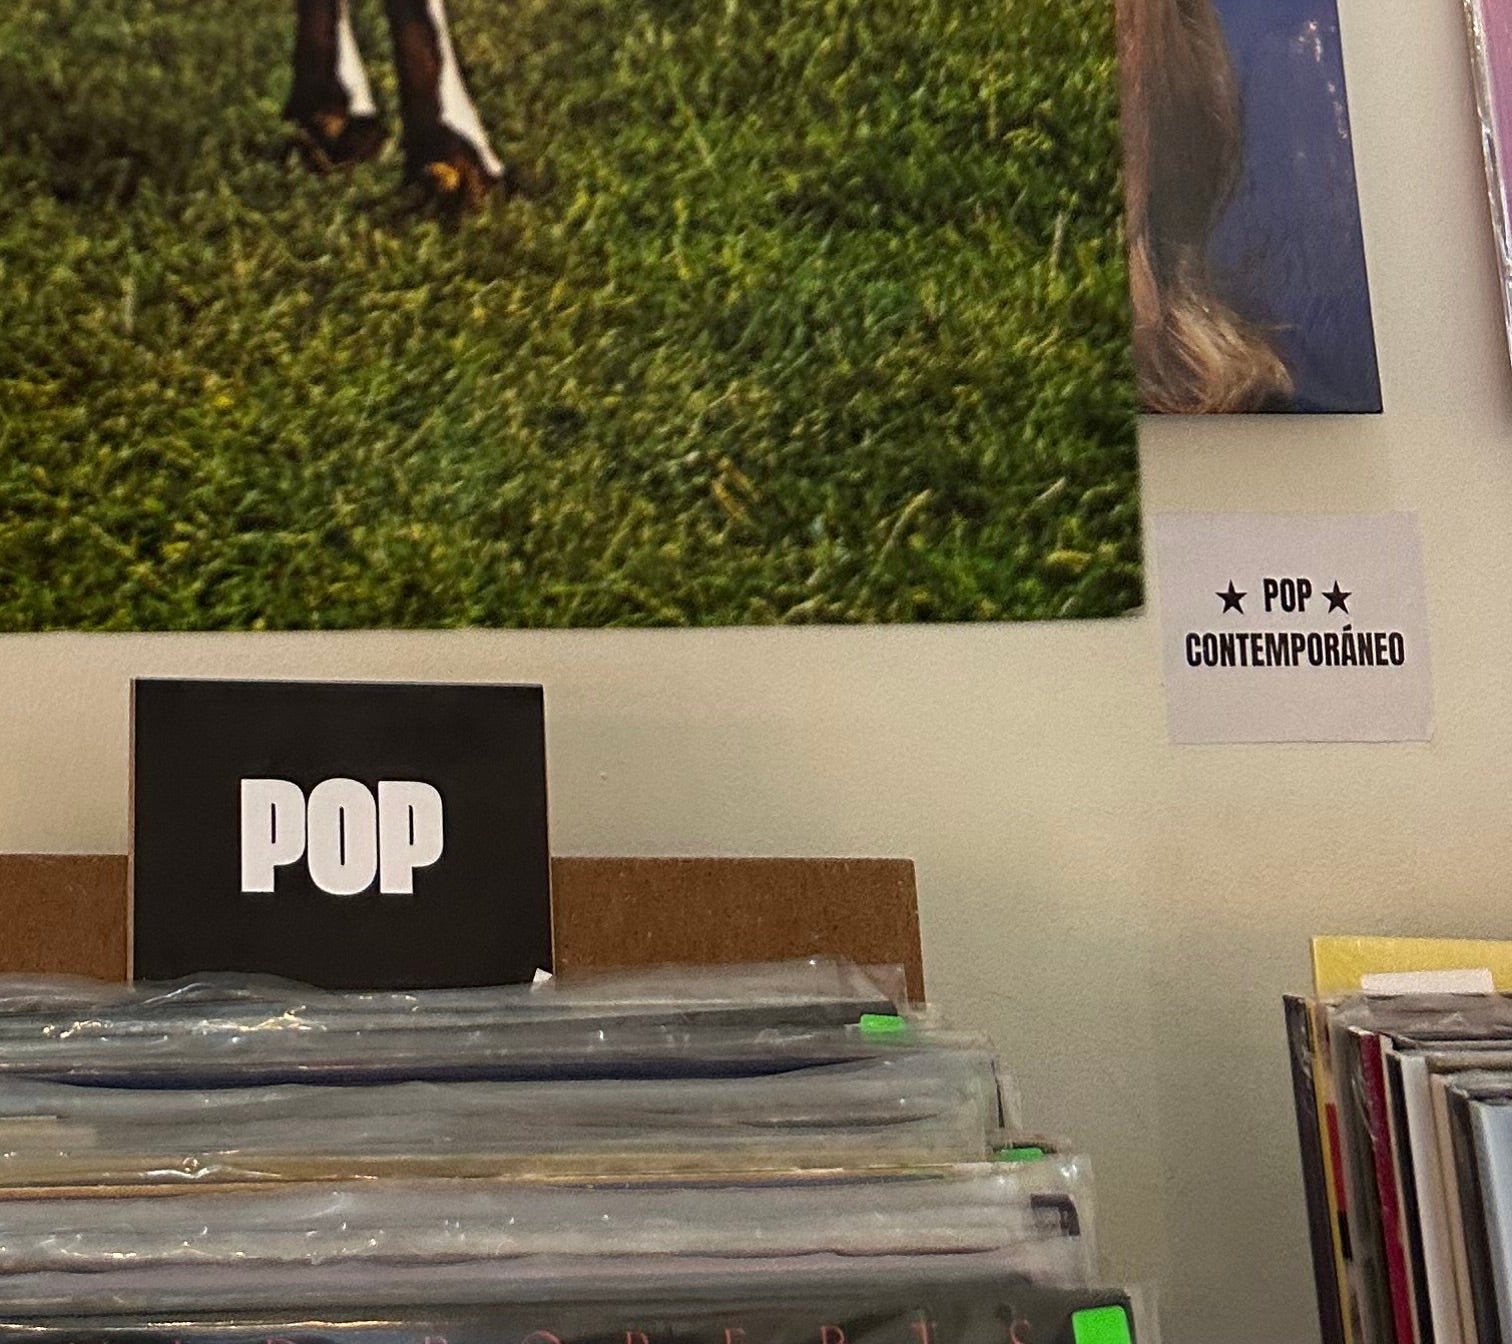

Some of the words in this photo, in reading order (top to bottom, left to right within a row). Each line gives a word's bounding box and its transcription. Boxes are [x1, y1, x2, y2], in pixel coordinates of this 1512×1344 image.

[1262, 577, 1314, 613] POP
[1185, 623, 1406, 669] CONTEMPORÁNEO
[239, 777, 446, 896] POP
